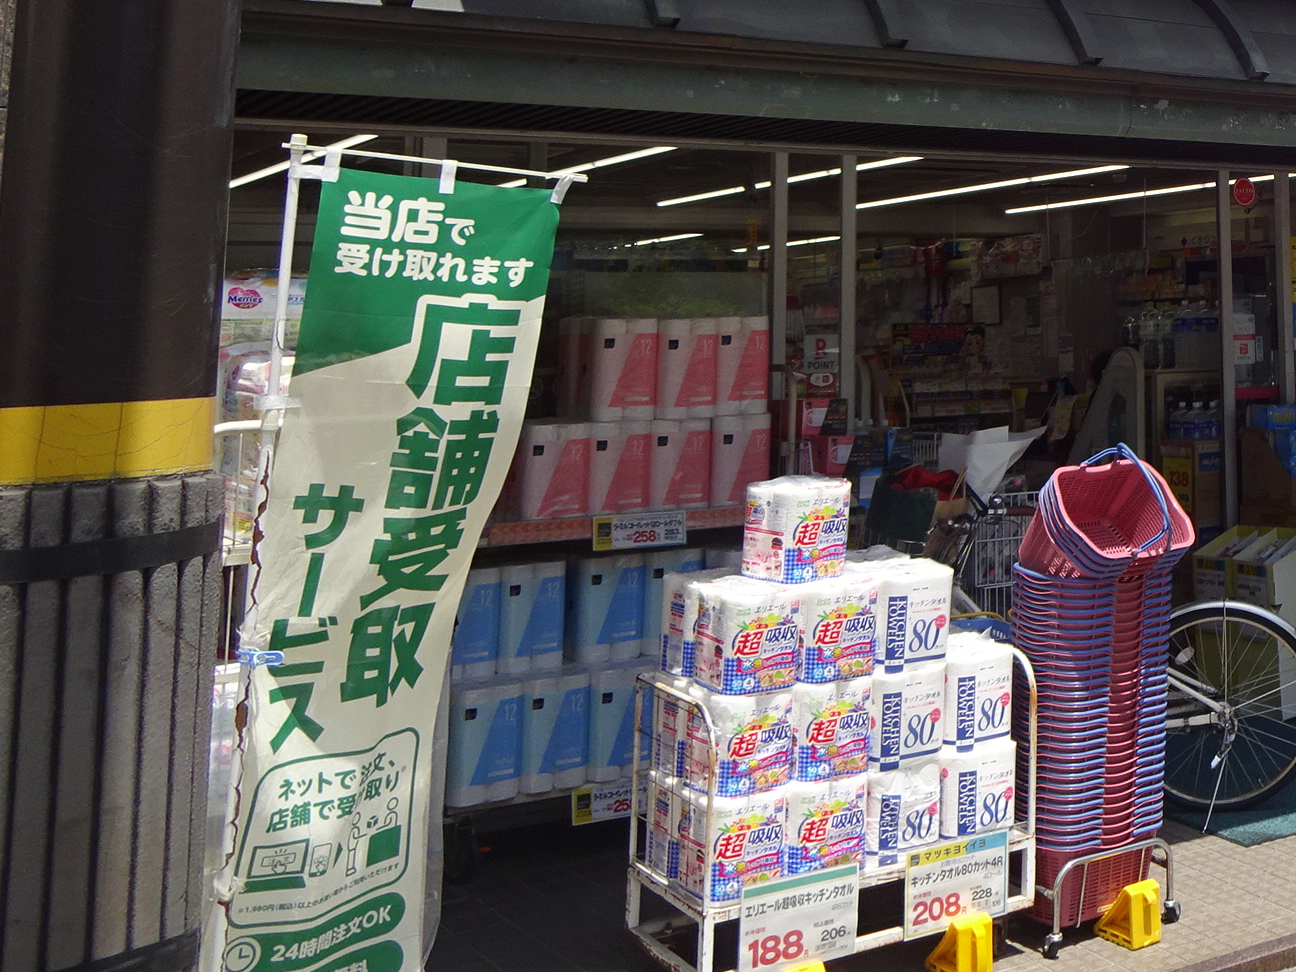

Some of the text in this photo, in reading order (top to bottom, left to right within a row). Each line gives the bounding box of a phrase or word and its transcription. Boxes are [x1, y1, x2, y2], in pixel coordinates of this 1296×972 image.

[340, 189, 475, 246] 当店で
[334, 242, 534, 288] 受け取れます
[227, 295, 264, 304] Merries
[808, 361, 836, 370] POINT
[1169, 470, 1189, 487] 138
[340, 301, 522, 708] 店舗受取
[813, 496, 840, 505] エリエール
[633, 530, 657, 543] 258
[755, 603, 787, 614] エリエール
[834, 594, 865, 604] エリエール
[267, 483, 365, 755] サービス
[887, 601, 897, 648] TOWELS
[895, 600, 907, 657] KITCHEN
[909, 619, 940, 652] 80
[751, 705, 781, 716] エリエール
[827, 691, 858, 701] エリエール
[958, 681, 967, 729] TOWELS
[966, 679, 975, 737] KITCHEN
[882, 698, 892, 746] TOWELS
[890, 696, 901, 755] KITCHEN
[904, 714, 936, 748] 80
[978, 697, 1006, 732] 80
[614, 798, 632, 813] 25
[736, 805, 769, 815] エリエール
[820, 790, 852, 800] エリエール
[959, 776, 968, 824] TOWELS
[966, 774, 976, 833] KITCHEN
[980, 792, 1008, 827] 80
[902, 809, 932, 842] 80
[924, 839, 986, 861] マツキヨイイヨ
[911, 856, 1003, 887] キッチンタオル80カット4R
[745, 883, 854, 918] エリエール超吸収キッチンタオル
[912, 893, 961, 927] 208
[972, 888, 992, 901] 228
[270, 905, 392, 962] 24時間注文OK
[748, 929, 804, 969] 188
[821, 925, 846, 942] 206
